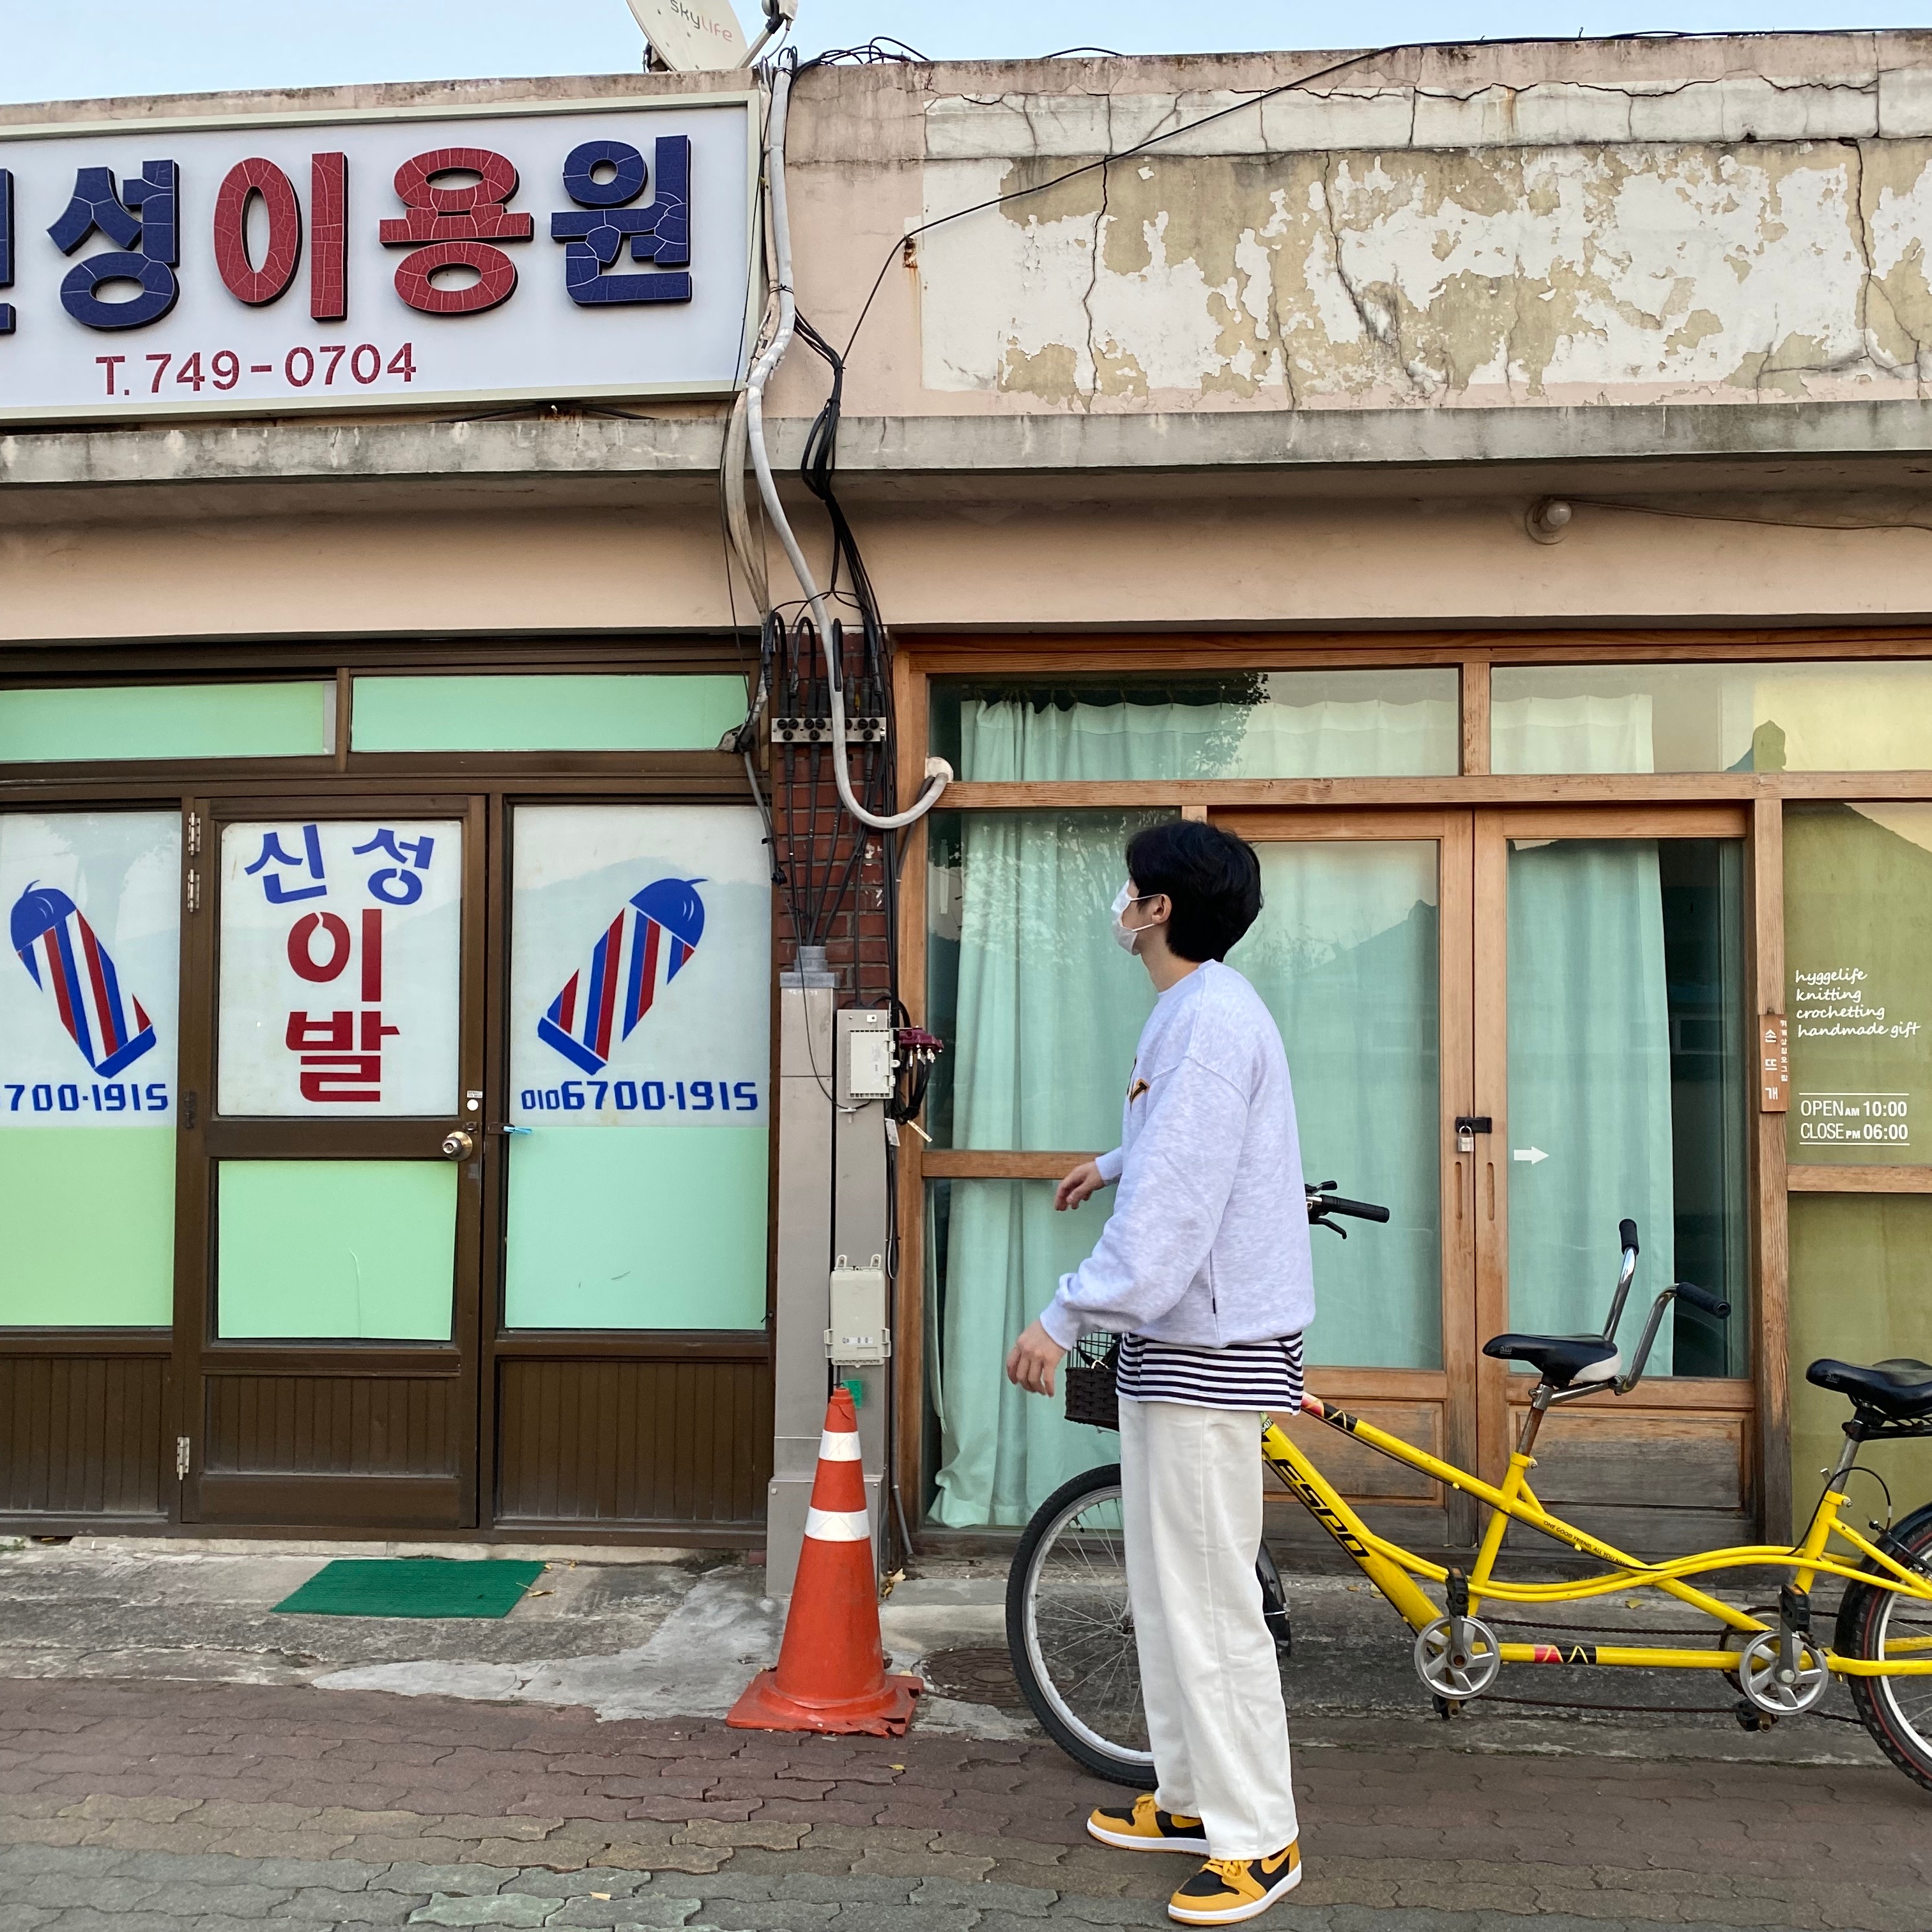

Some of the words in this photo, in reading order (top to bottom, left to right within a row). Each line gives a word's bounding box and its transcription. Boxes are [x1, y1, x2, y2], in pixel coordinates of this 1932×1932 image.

[243, 824, 435, 905] 신성
[1795, 968, 1868, 985] hyggelife
[1796, 987, 1862, 1003] knitting
[286, 908, 401, 1102] 이발
[1796, 1004, 1885, 1020] crochetting
[1797, 1022, 1889, 1038] handmade
[1890, 1021, 1920, 1038] gift
[1800, 1100, 1844, 1116] OPEN
[1863, 1101, 1907, 1117] 10:00
[1800, 1123, 1844, 1139] CLOSE
[1863, 1124, 1908, 1140] 06:00
[1556, 1528, 1572, 1538] GOOD
